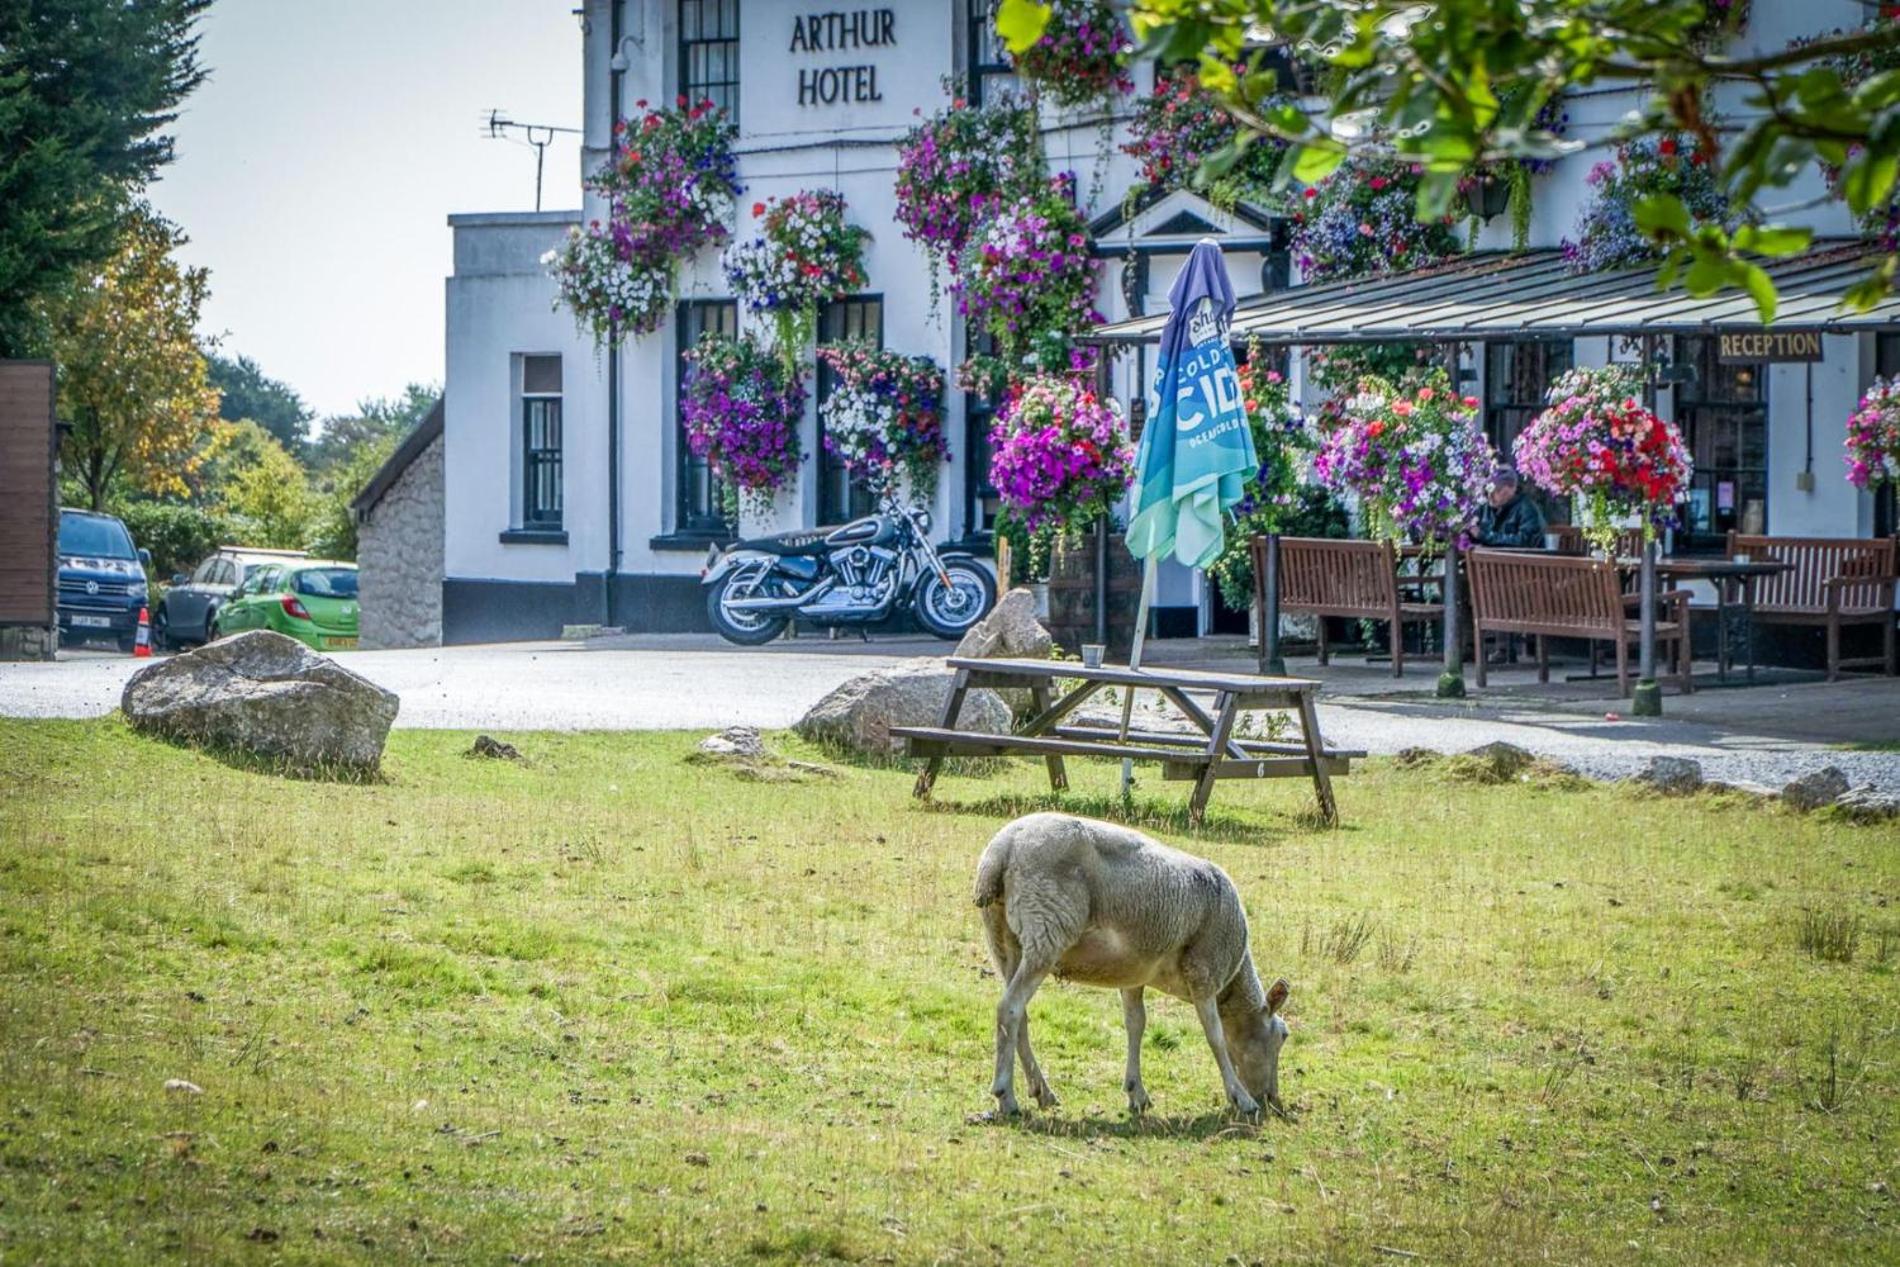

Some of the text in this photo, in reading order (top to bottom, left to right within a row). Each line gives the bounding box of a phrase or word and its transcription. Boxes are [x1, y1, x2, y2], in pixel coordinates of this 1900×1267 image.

[789, 8, 897, 53] ARTHUR
[798, 65, 882, 107] HOTEL
[1720, 333, 1820, 356] RECEPTION
[1257, 762, 1265, 778] 6
